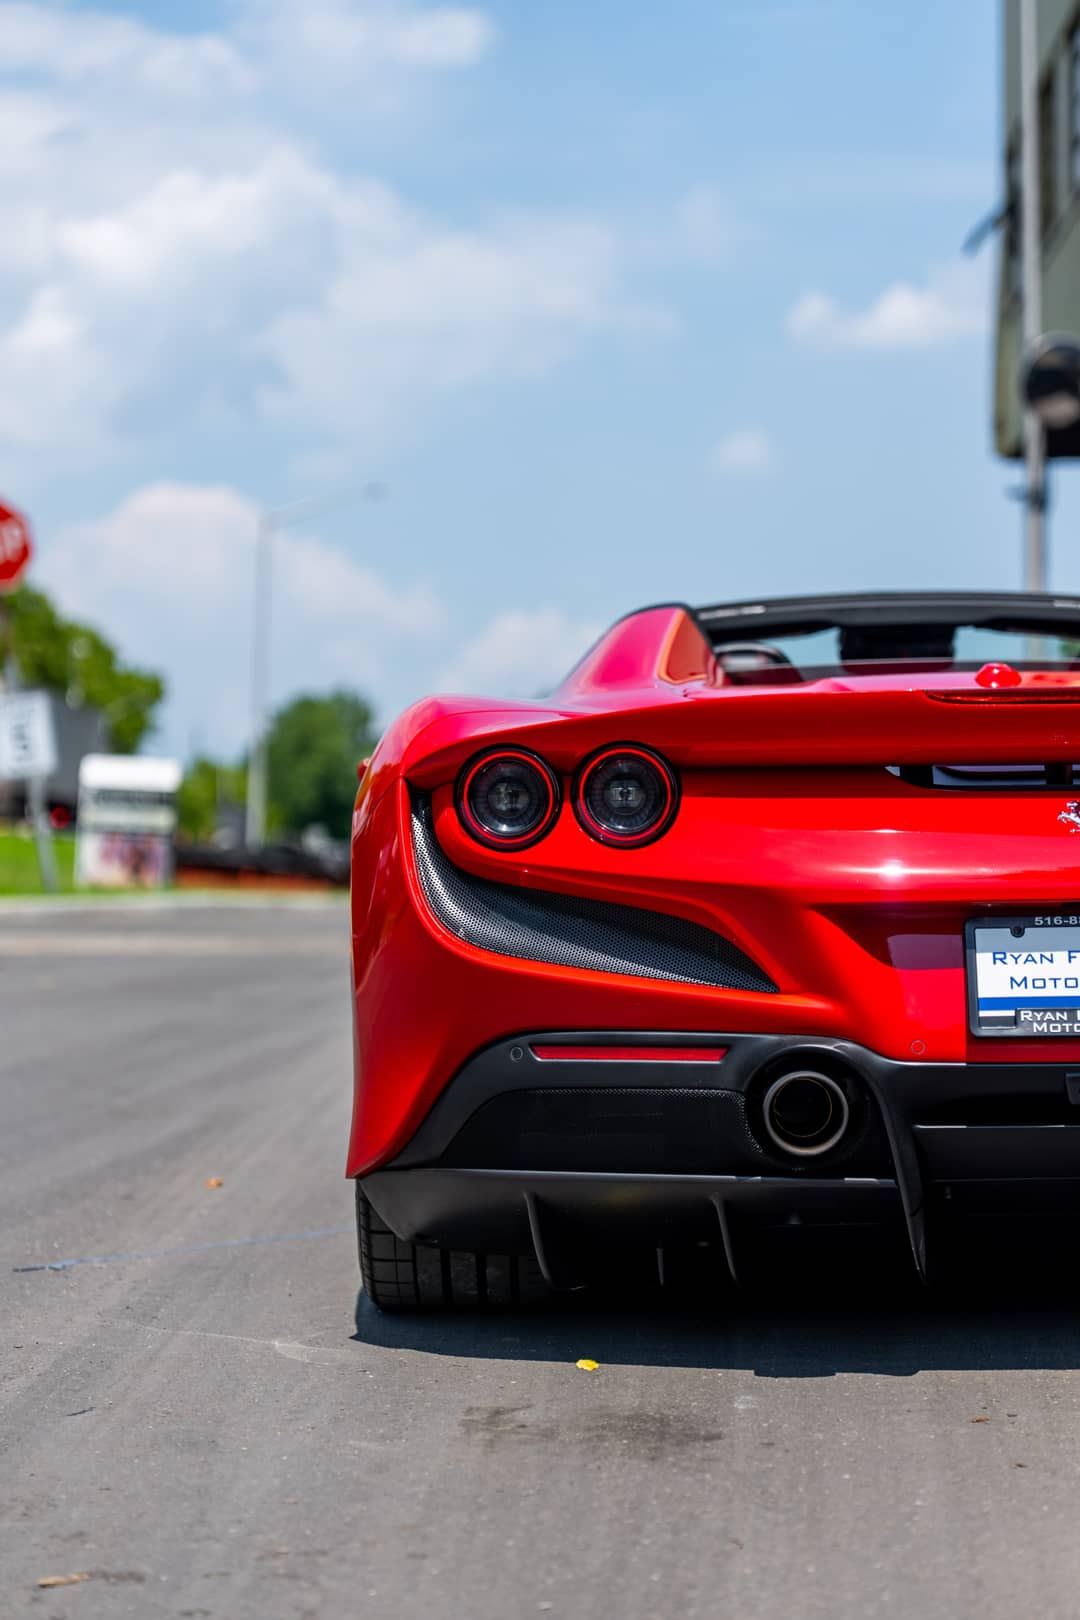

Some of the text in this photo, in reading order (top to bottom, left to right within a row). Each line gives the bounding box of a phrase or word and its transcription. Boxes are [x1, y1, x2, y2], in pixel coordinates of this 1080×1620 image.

[1034, 916, 1080, 926] 516-8
[992, 951, 1054, 965] RYAN
[1010, 975, 1079, 989] MOTO
[1020, 1010, 1068, 1021] RYAN
